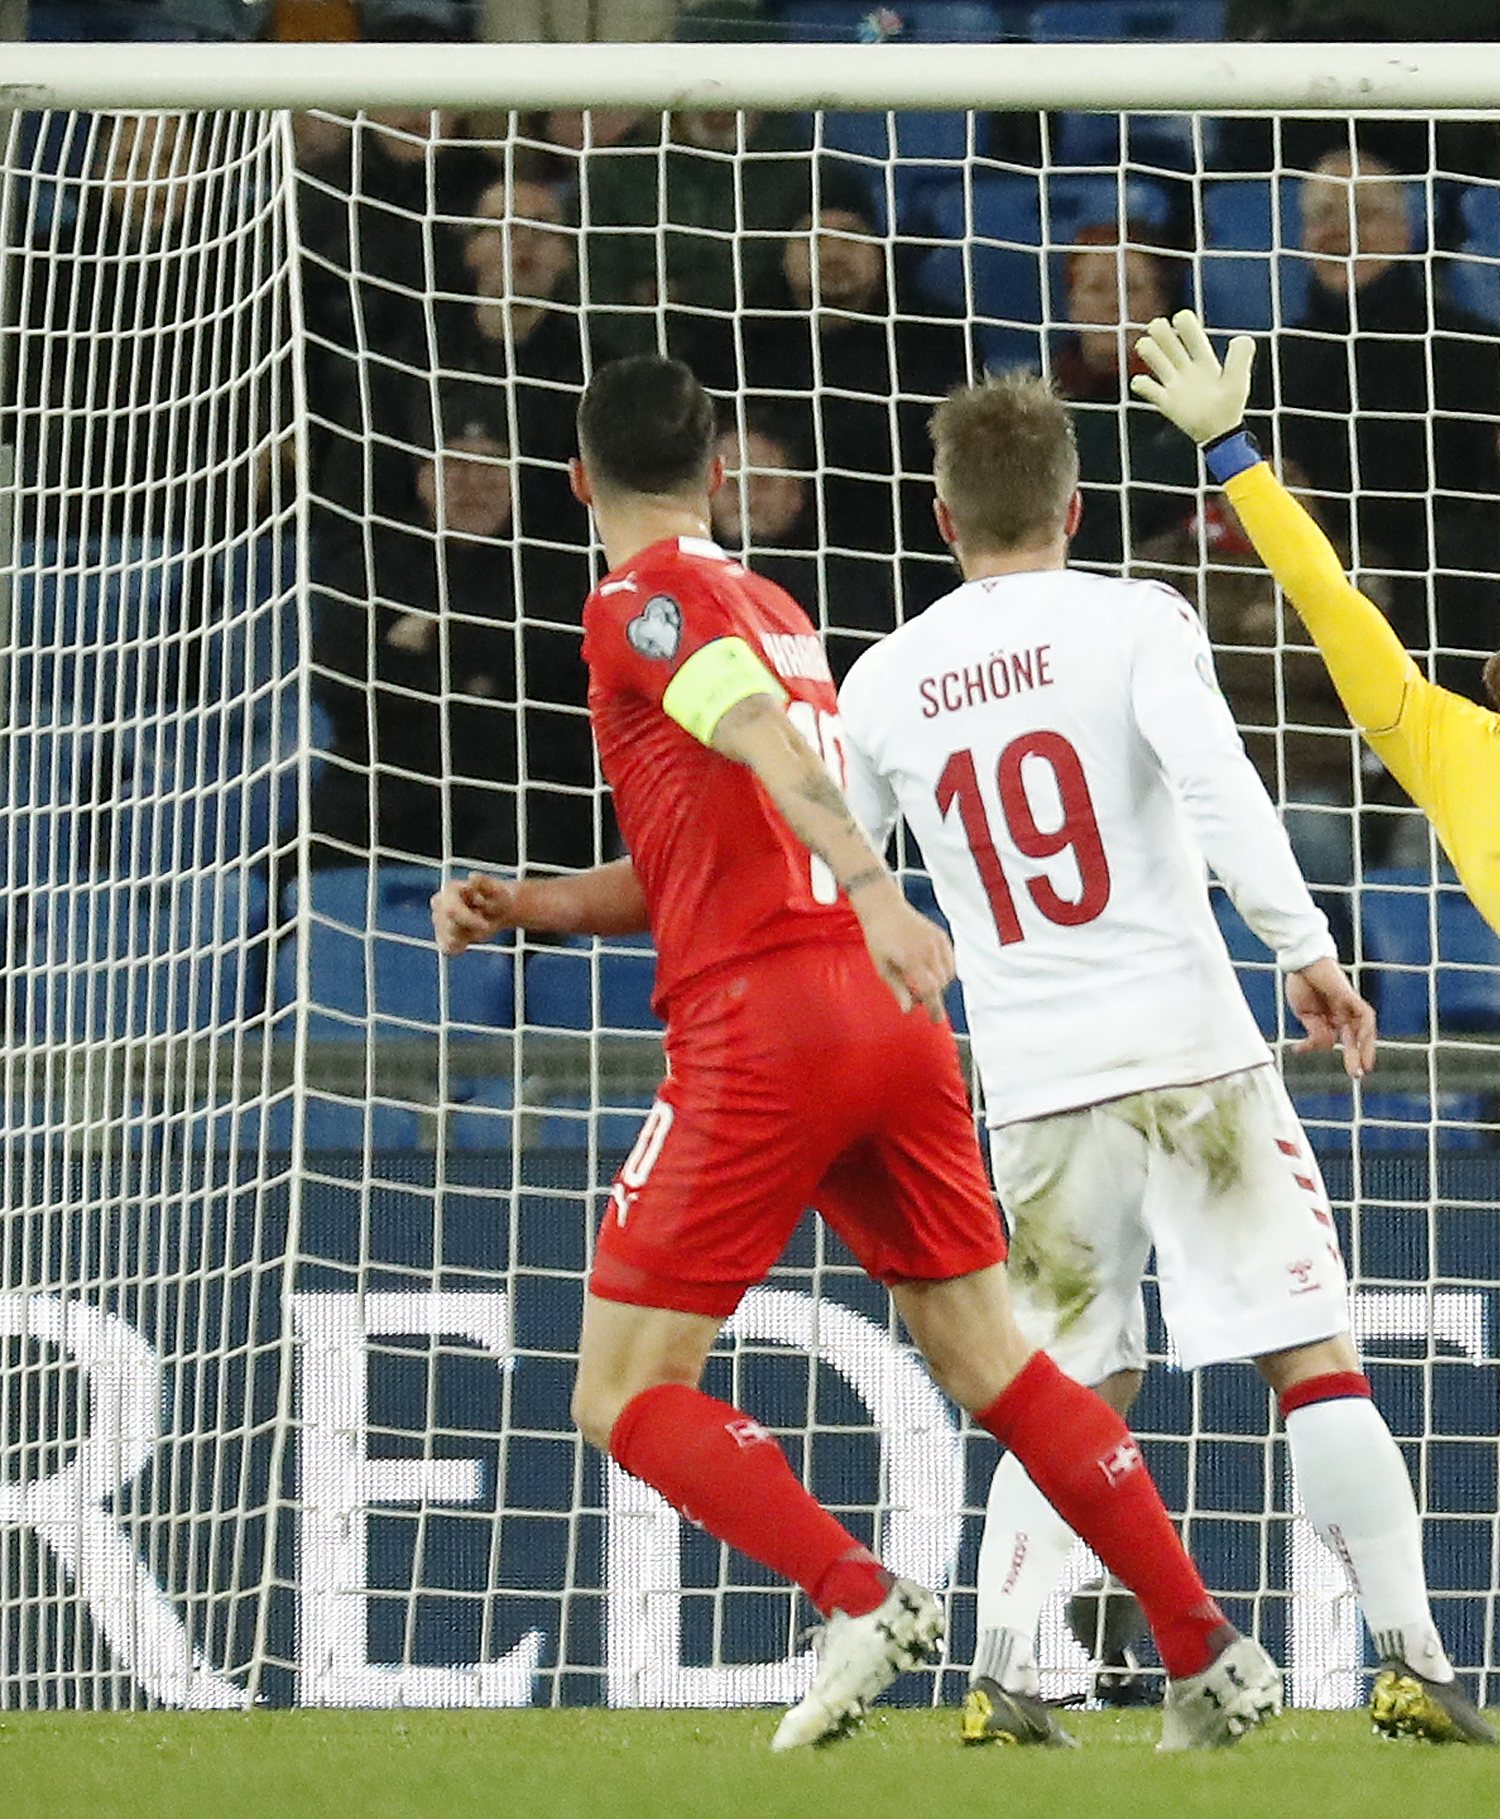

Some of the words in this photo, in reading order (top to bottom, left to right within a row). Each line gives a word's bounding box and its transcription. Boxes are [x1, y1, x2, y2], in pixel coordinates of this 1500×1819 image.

[919, 644, 1054, 719] SCHÖNE
[934, 729, 1111, 946] 19
[0, 1285, 1489, 1709] REDT
